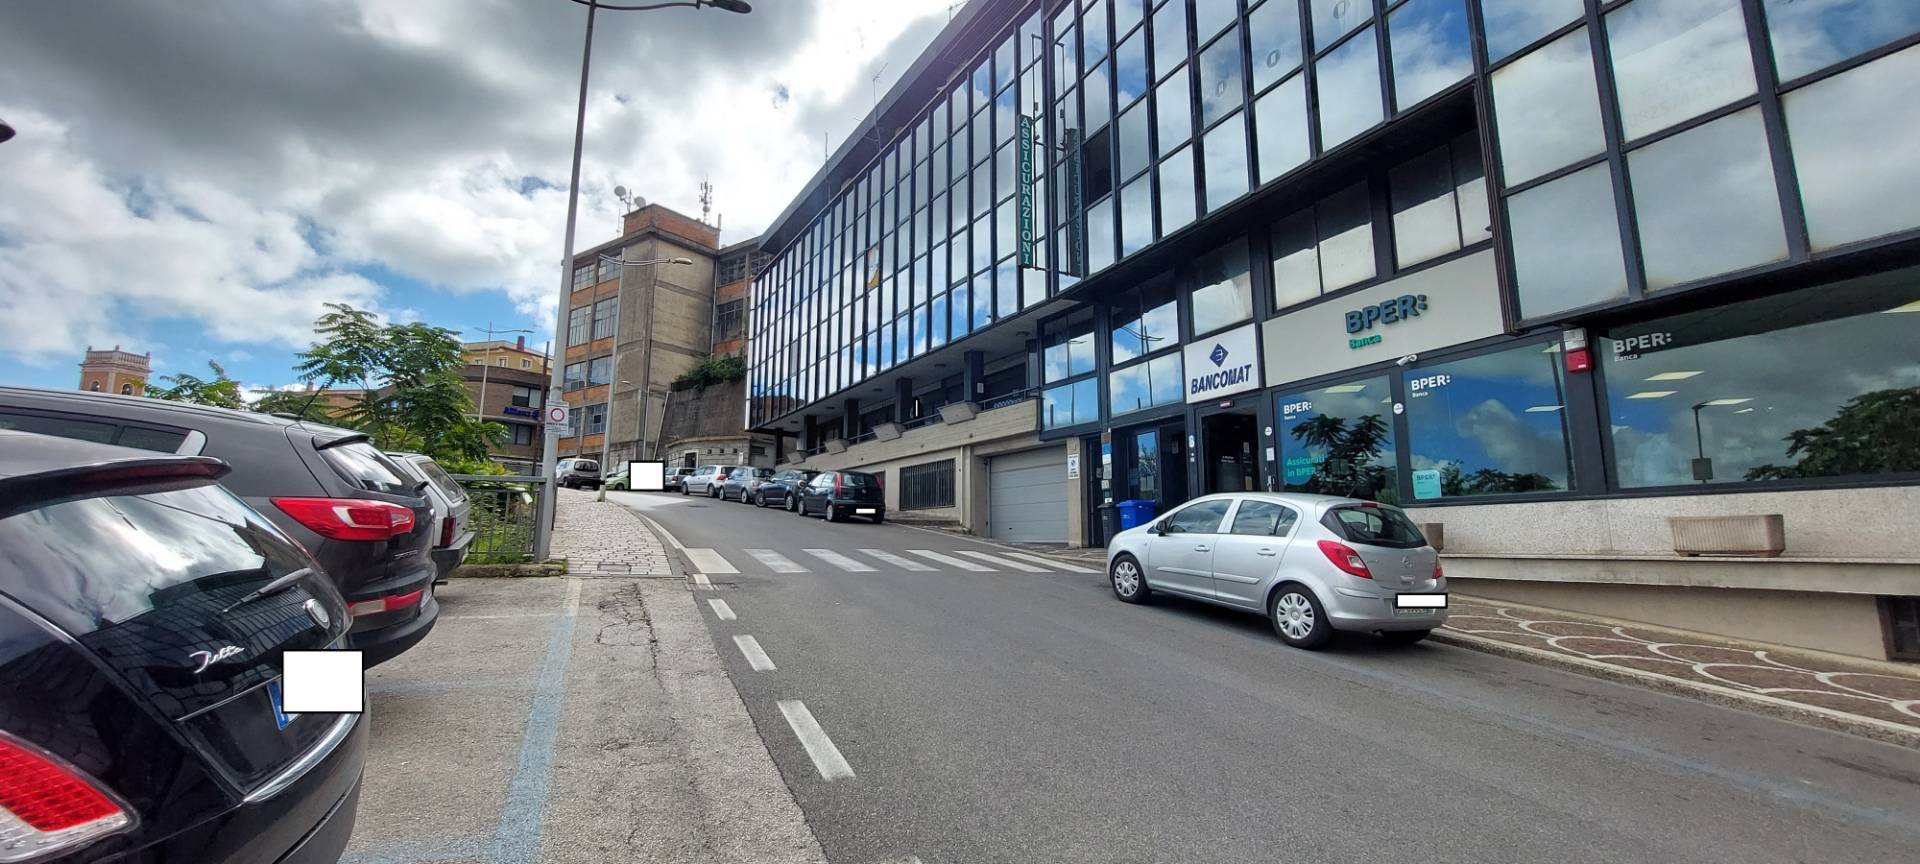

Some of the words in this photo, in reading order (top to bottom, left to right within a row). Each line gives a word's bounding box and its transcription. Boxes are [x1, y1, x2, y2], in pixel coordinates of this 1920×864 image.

[1021, 117, 1033, 265] ASSICURAZIONI
[1349, 334, 1382, 350] Banca
[1614, 353, 1638, 362] Banca
[1190, 364, 1252, 395] BANCOMAT
[1412, 391, 1429, 399] Banca
